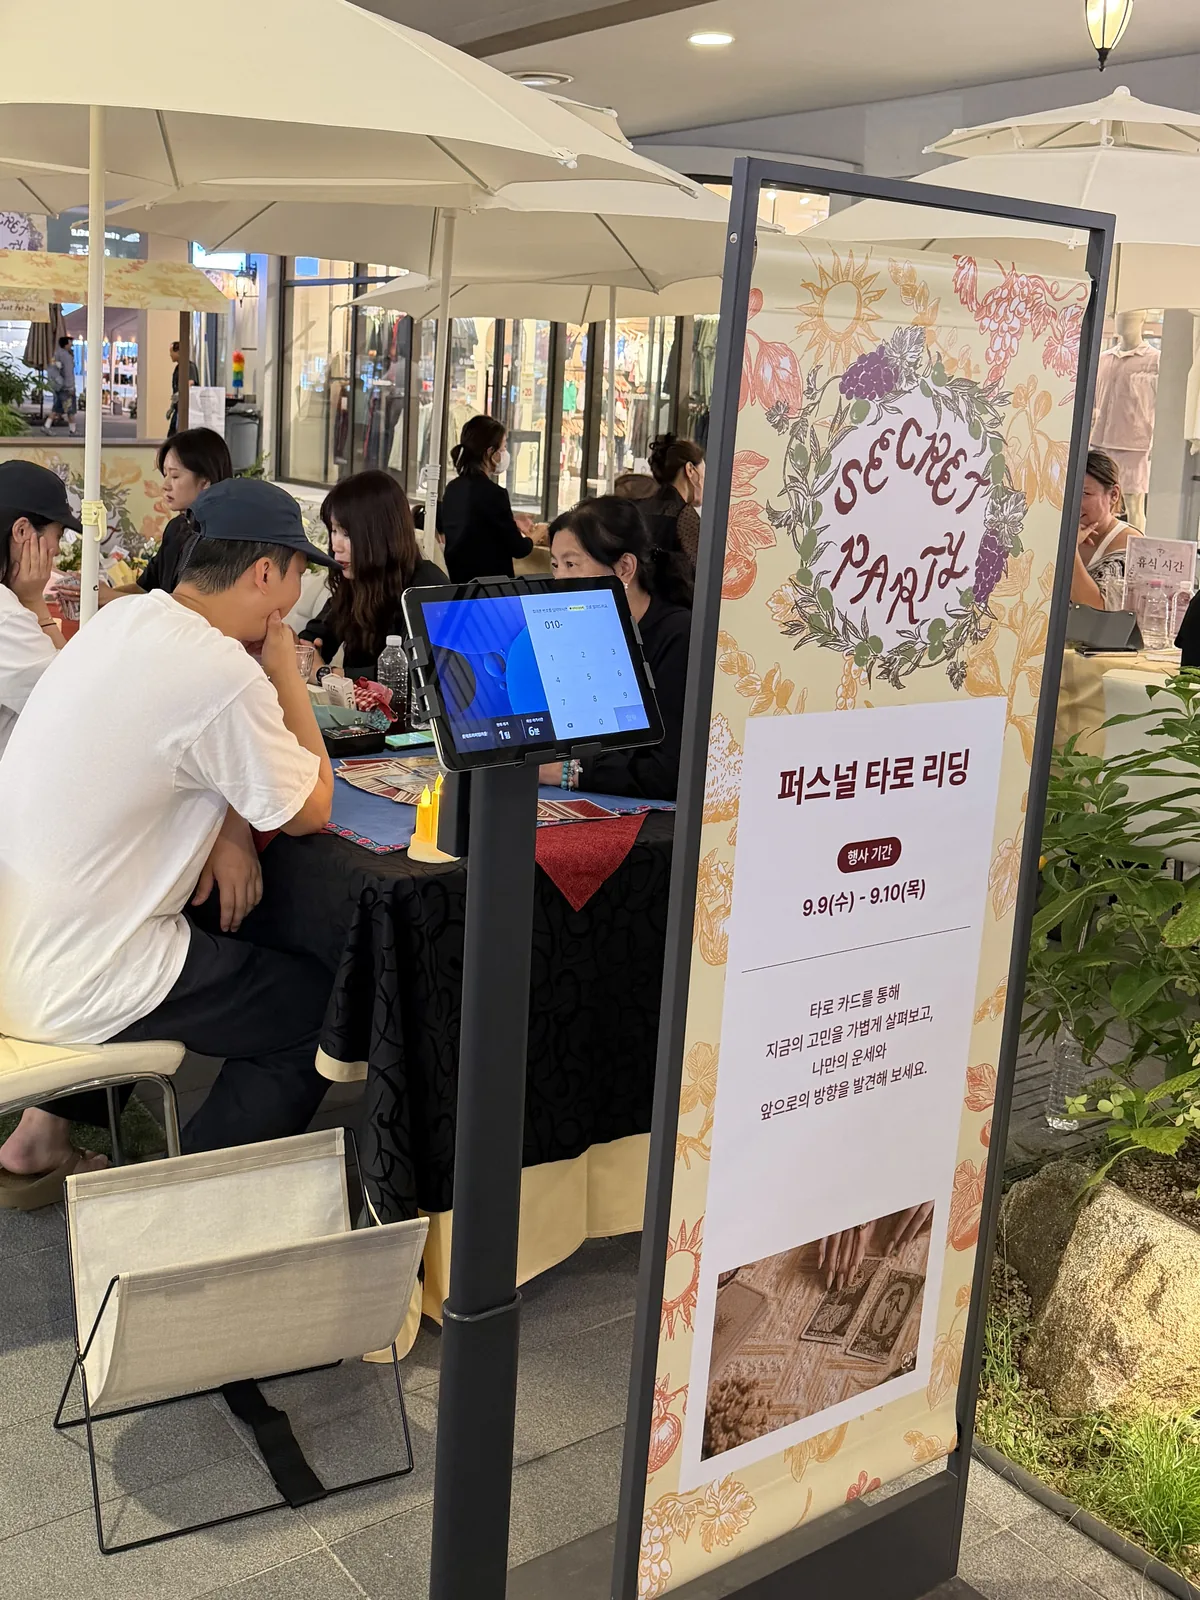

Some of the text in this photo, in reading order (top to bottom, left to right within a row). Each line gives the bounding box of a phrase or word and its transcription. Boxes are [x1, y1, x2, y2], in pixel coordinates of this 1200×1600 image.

[834, 417, 991, 515] SECRET
[830, 531, 969, 625] PARTY
[1136, 556, 1158, 570] 휴식
[1161, 559, 1185, 574] 시간
[580, 651, 586, 659] 2
[610, 648, 616, 656] 3
[586, 672, 592, 681] 5
[617, 669, 623, 677] 6
[561, 691, 628, 706] 7 8 9
[598, 717, 604, 726] 0
[777, 748, 970, 806] 퍼스널 타로 리딩
[847, 844, 893, 866] 행사 기간
[802, 890, 855, 917] 9.9(수)
[870, 878, 926, 905] 9.10(목)
[809, 983, 901, 1019] 타로 카드를 통해
[765, 1005, 933, 1059] 지금의 고민을 가볍게 살펴보고,
[812, 1042, 888, 1076] 나만의 운세와
[760, 1061, 928, 1121] 앞으로의 방향을 발견해 보세요.
